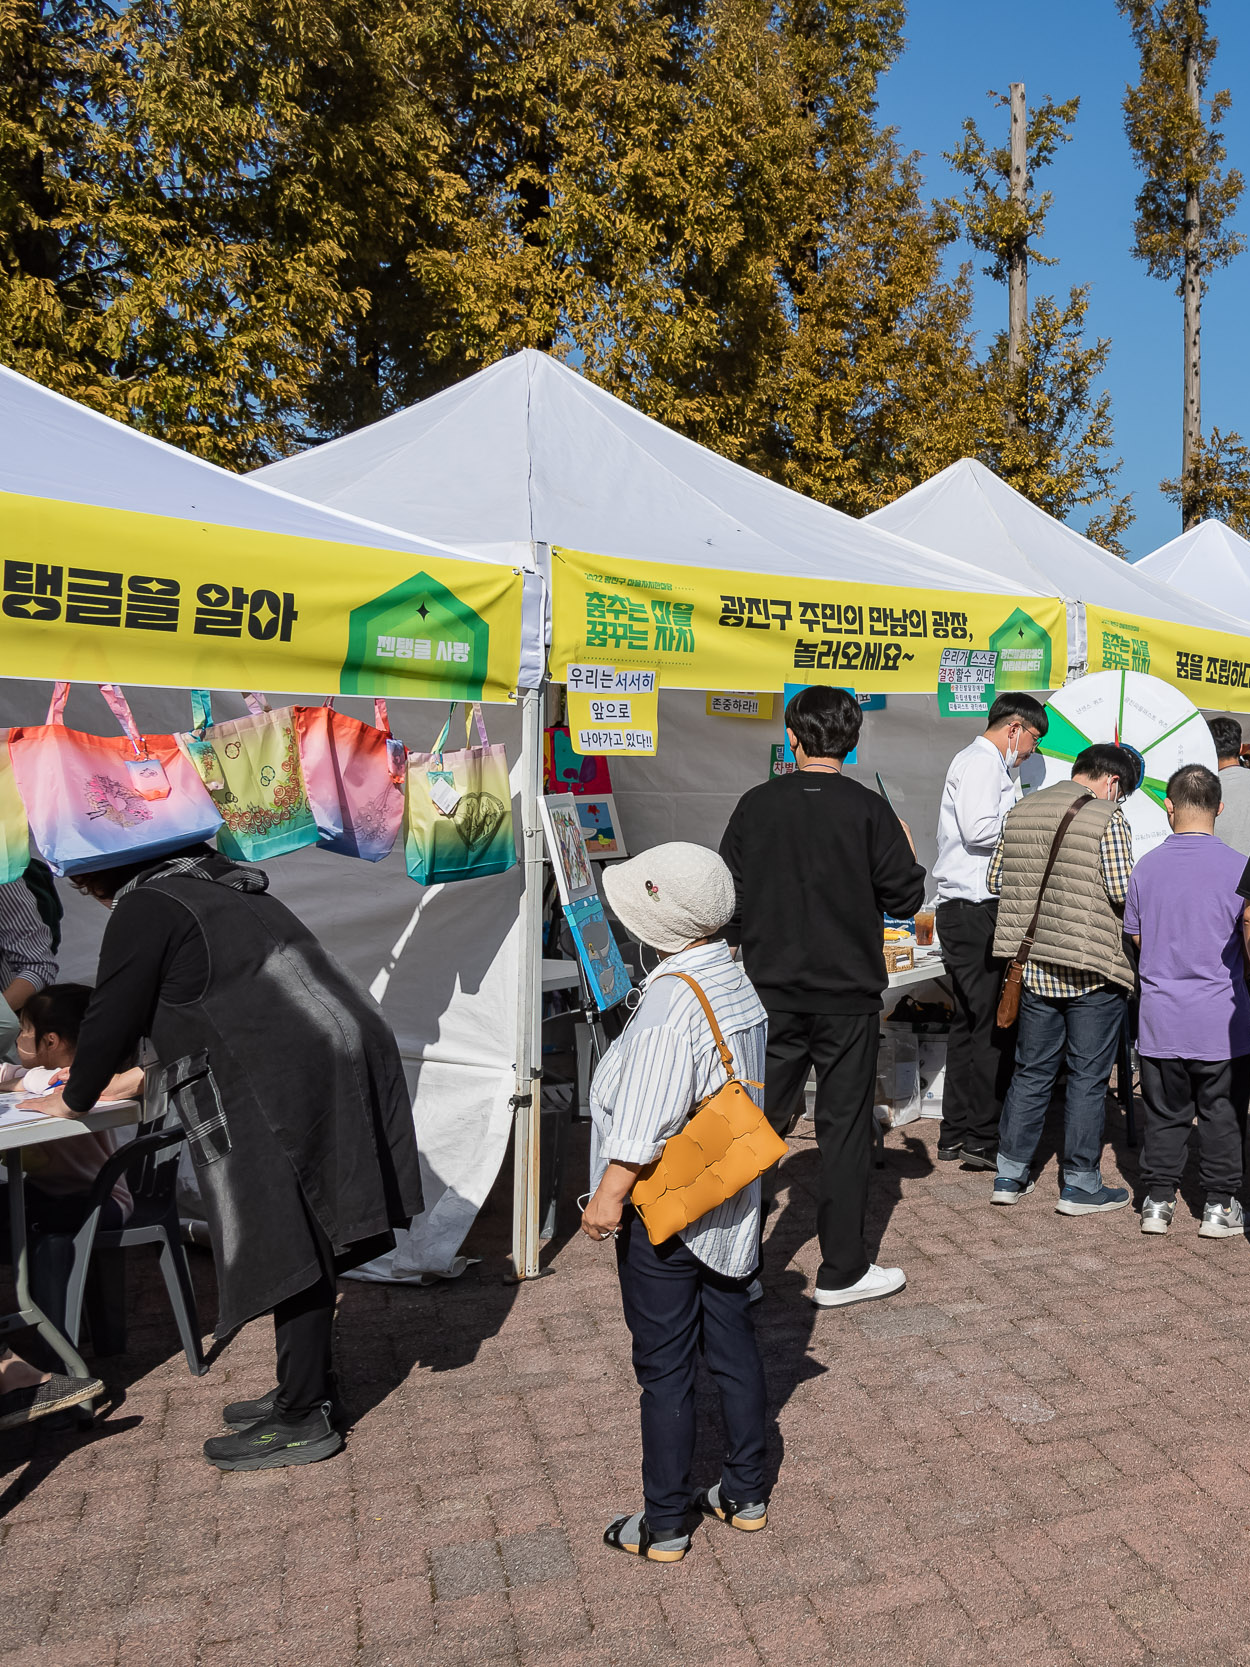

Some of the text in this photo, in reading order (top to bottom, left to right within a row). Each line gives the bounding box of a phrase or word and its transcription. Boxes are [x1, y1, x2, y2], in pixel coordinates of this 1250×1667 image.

[604, 575, 627, 586] 광진구
[2, 559, 299, 643] 탱글을 알아
[585, 591, 695, 627] 춤추는 마을
[718, 595, 974, 643] 광진구 주민의 만남의 광장,
[586, 619, 695, 653] 꿈꾸는 자치
[1101, 631, 1151, 658] 춤추는 마을
[435, 640, 471, 663] 사랑
[794, 638, 915, 671] 놀러오세요~
[942, 649, 996, 667] 우리가 스스로
[1101, 649, 1151, 675] 꿈꾸는 자치
[976, 668, 995, 683] 있다!
[1175, 650, 1204, 682] 꿈을
[569, 668, 655, 692] 우리는 서서히
[592, 702, 631, 720] 앞으로
[711, 697, 759, 714] 존중하라!!
[580, 732, 653, 749] 나아가고 있다!!
